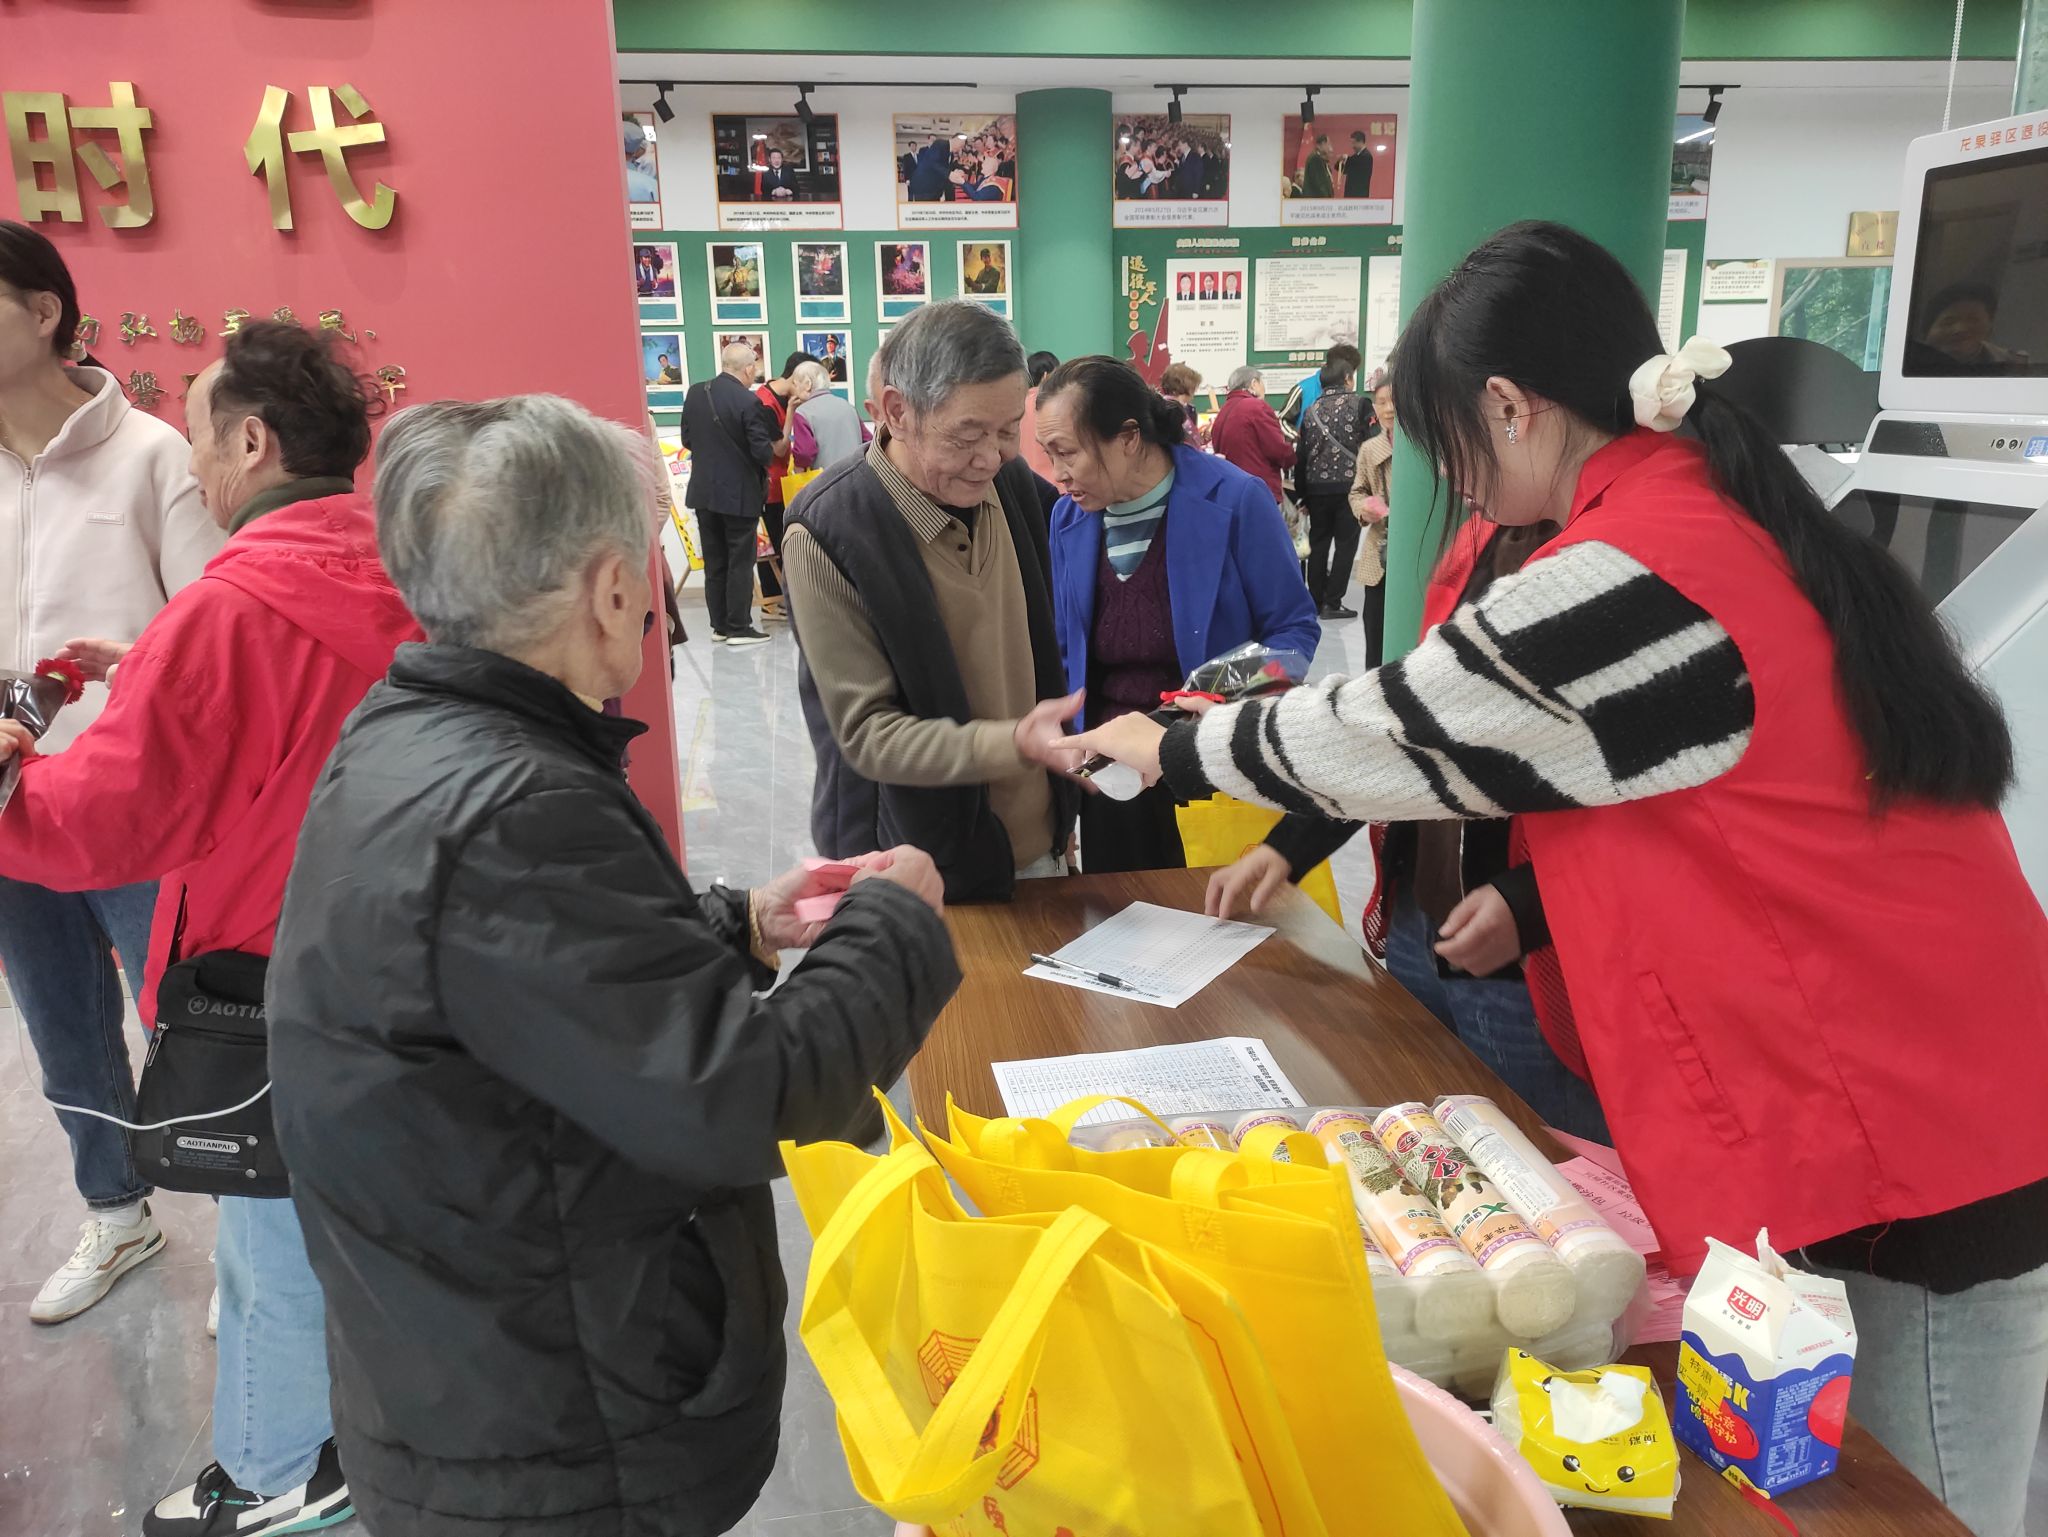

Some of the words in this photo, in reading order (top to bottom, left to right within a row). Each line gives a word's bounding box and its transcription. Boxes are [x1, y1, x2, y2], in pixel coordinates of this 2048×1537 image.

[4, 81, 396, 230] 时代
[186, 1140, 231, 1151] AOTIANPAI
[1730, 1288, 1765, 1318] 光明
[1689, 1357, 1713, 1385] 特惠
